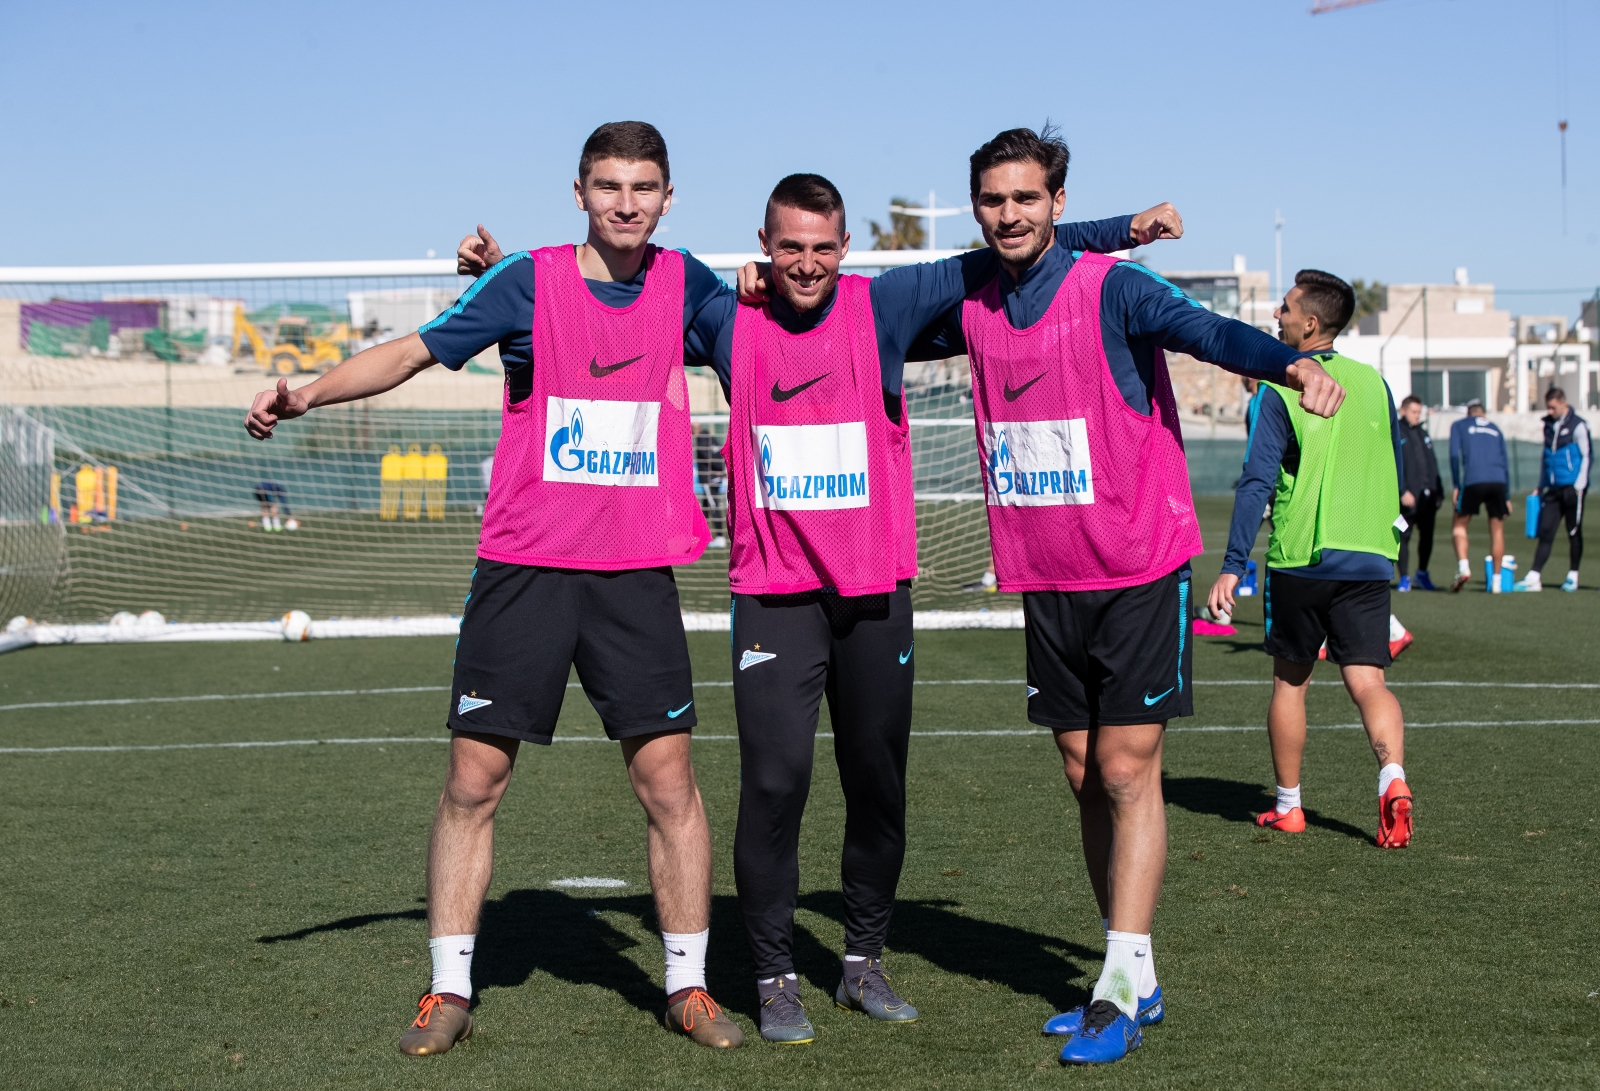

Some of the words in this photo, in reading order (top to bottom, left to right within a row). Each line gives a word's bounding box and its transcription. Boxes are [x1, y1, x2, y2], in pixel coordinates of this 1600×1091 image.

[587, 449, 655, 475] GAZPROM
[776, 472, 866, 499] GAZPROM
[1014, 469, 1088, 496] GAZPROM
